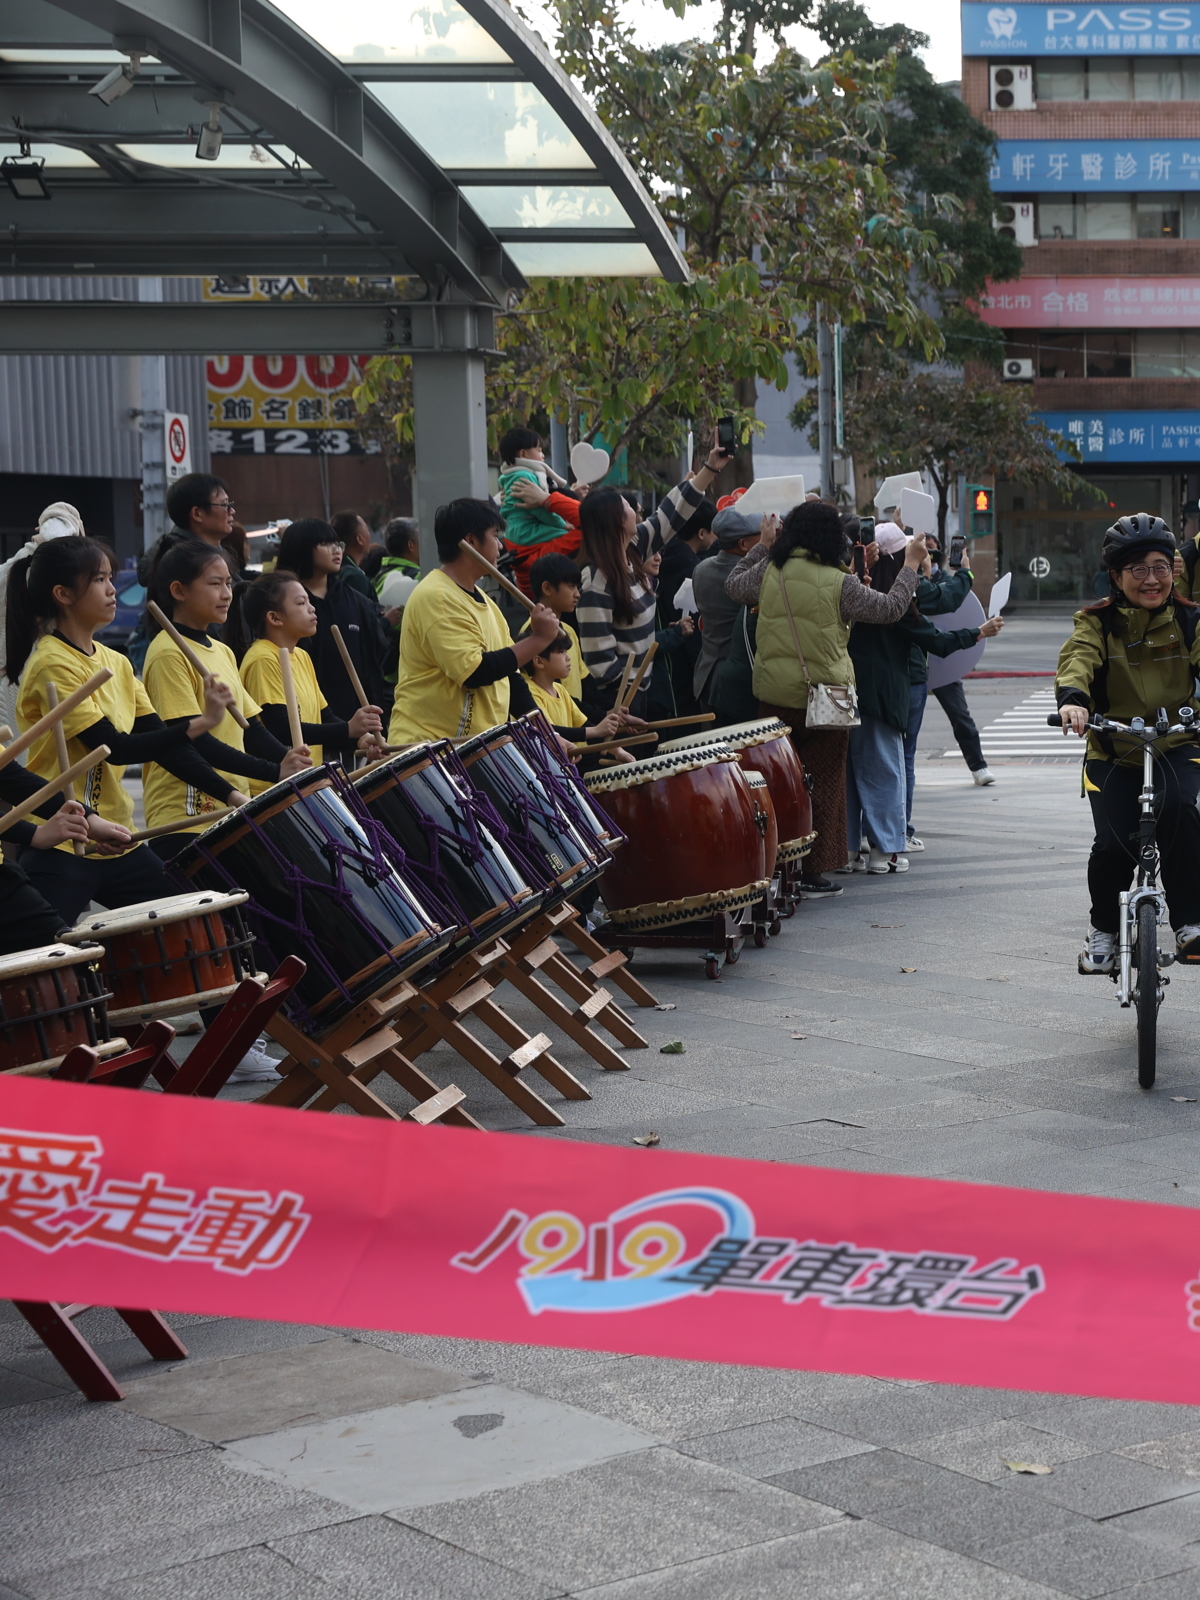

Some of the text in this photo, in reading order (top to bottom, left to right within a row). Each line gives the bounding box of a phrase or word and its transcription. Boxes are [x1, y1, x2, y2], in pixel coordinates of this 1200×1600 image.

[980, 39, 1027, 49] PASSION
[1044, 34, 1168, 50] 台大專科醫師團隊
[980, 294, 1031, 309] 台北市
[1042, 292, 1089, 312] 合格
[1068, 419, 1104, 436] 唯美
[1109, 428, 1146, 446] 診所
